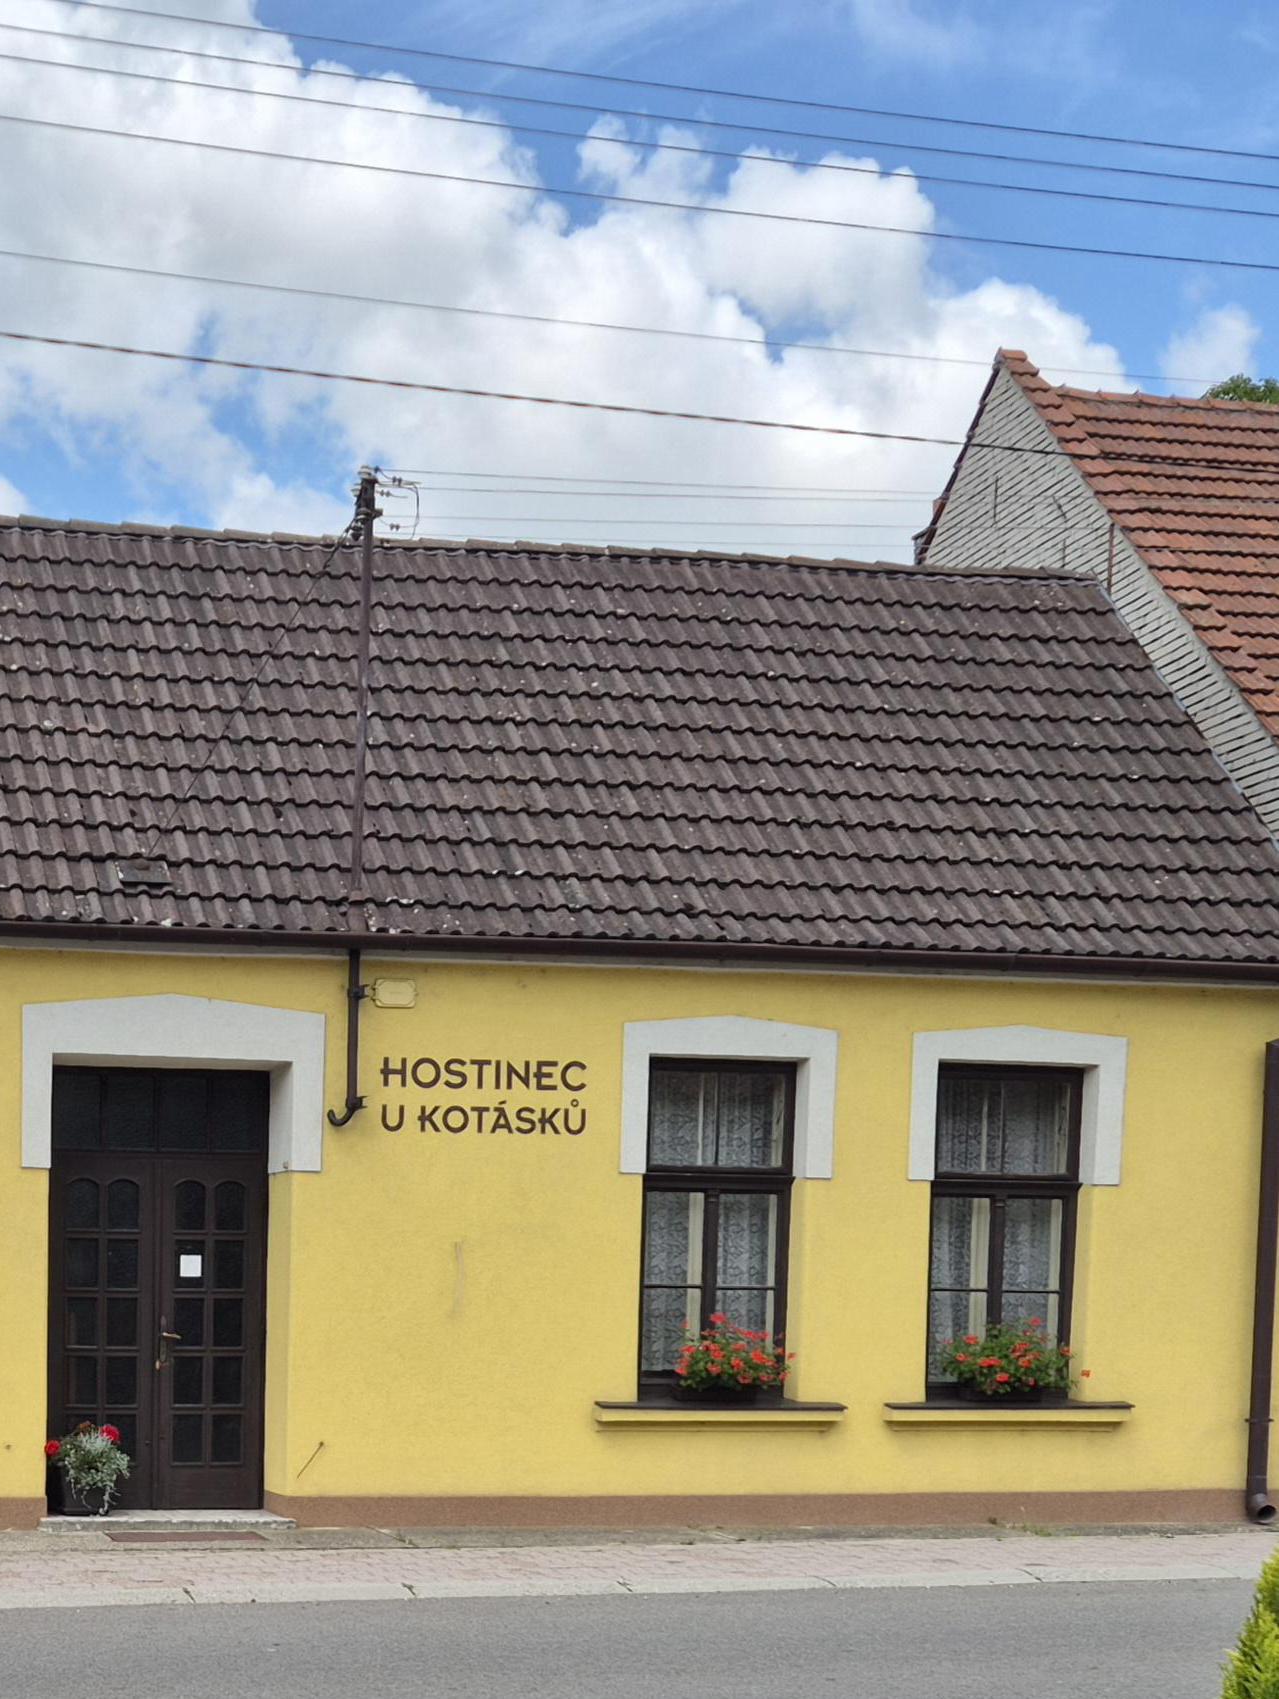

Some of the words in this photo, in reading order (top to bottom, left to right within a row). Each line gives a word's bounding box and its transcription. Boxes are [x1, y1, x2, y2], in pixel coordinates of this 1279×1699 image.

[380, 1056, 588, 1092] HOSTINEC
[381, 1104, 405, 1132] U
[417, 1098, 587, 1136] KOTÁSKŮ
